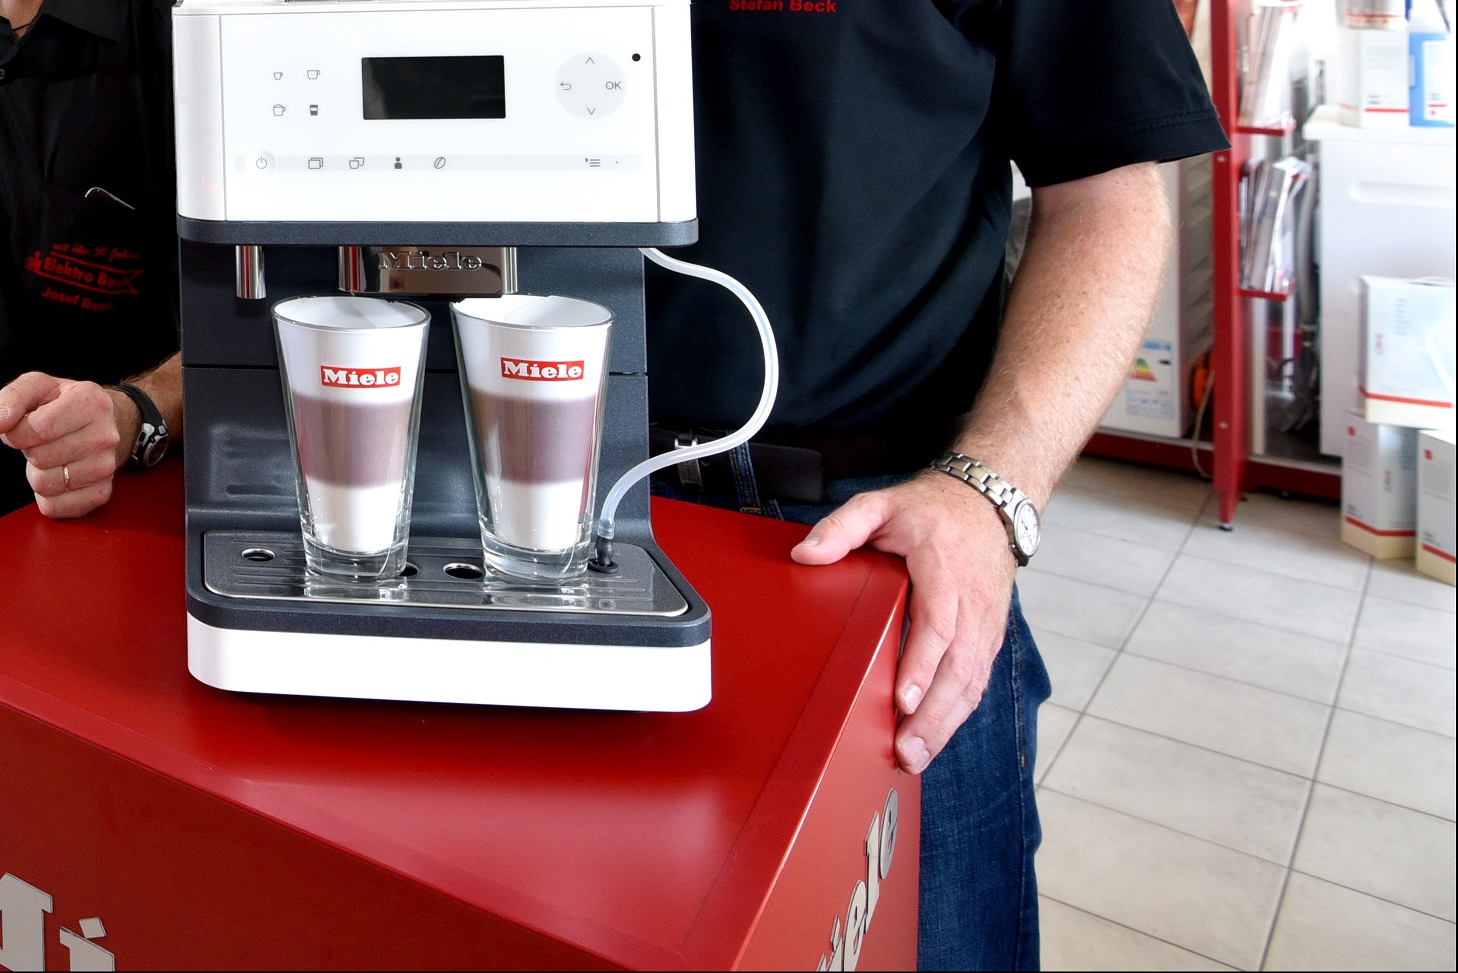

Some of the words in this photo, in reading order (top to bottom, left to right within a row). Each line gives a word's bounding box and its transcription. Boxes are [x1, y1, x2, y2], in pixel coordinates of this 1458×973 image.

[605, 80, 622, 91] OK
[43, 257, 95, 283] Elektro
[378, 251, 483, 272] Miele
[42, 285, 80, 306] Josef
[81, 296, 113, 312] Beck
[322, 367, 400, 387] Miele
[503, 360, 584, 380] Miele
